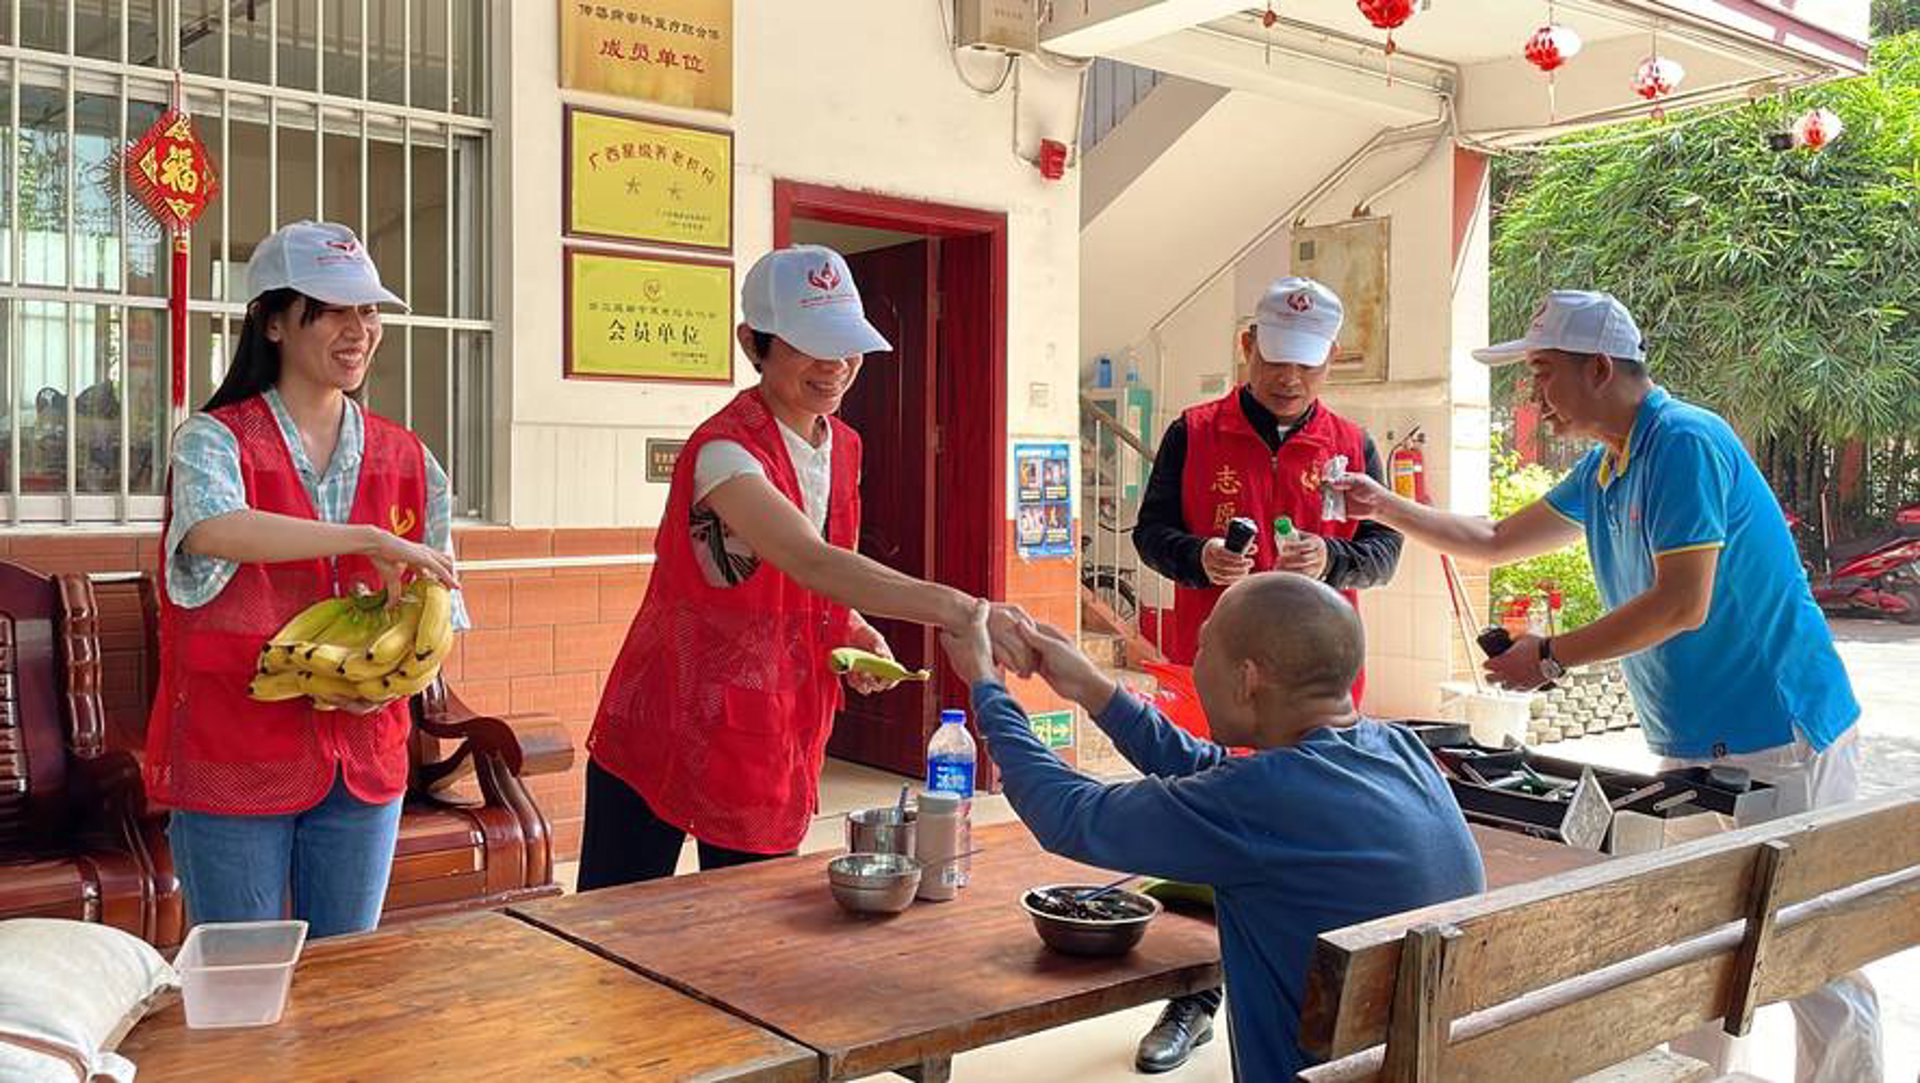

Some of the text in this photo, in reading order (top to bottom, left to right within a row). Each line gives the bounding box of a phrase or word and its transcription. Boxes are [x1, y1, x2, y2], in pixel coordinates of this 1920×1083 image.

[599, 39, 705, 73] 成员单位
[160, 144, 199, 194] 福
[608, 319, 701, 345] 会员单位
